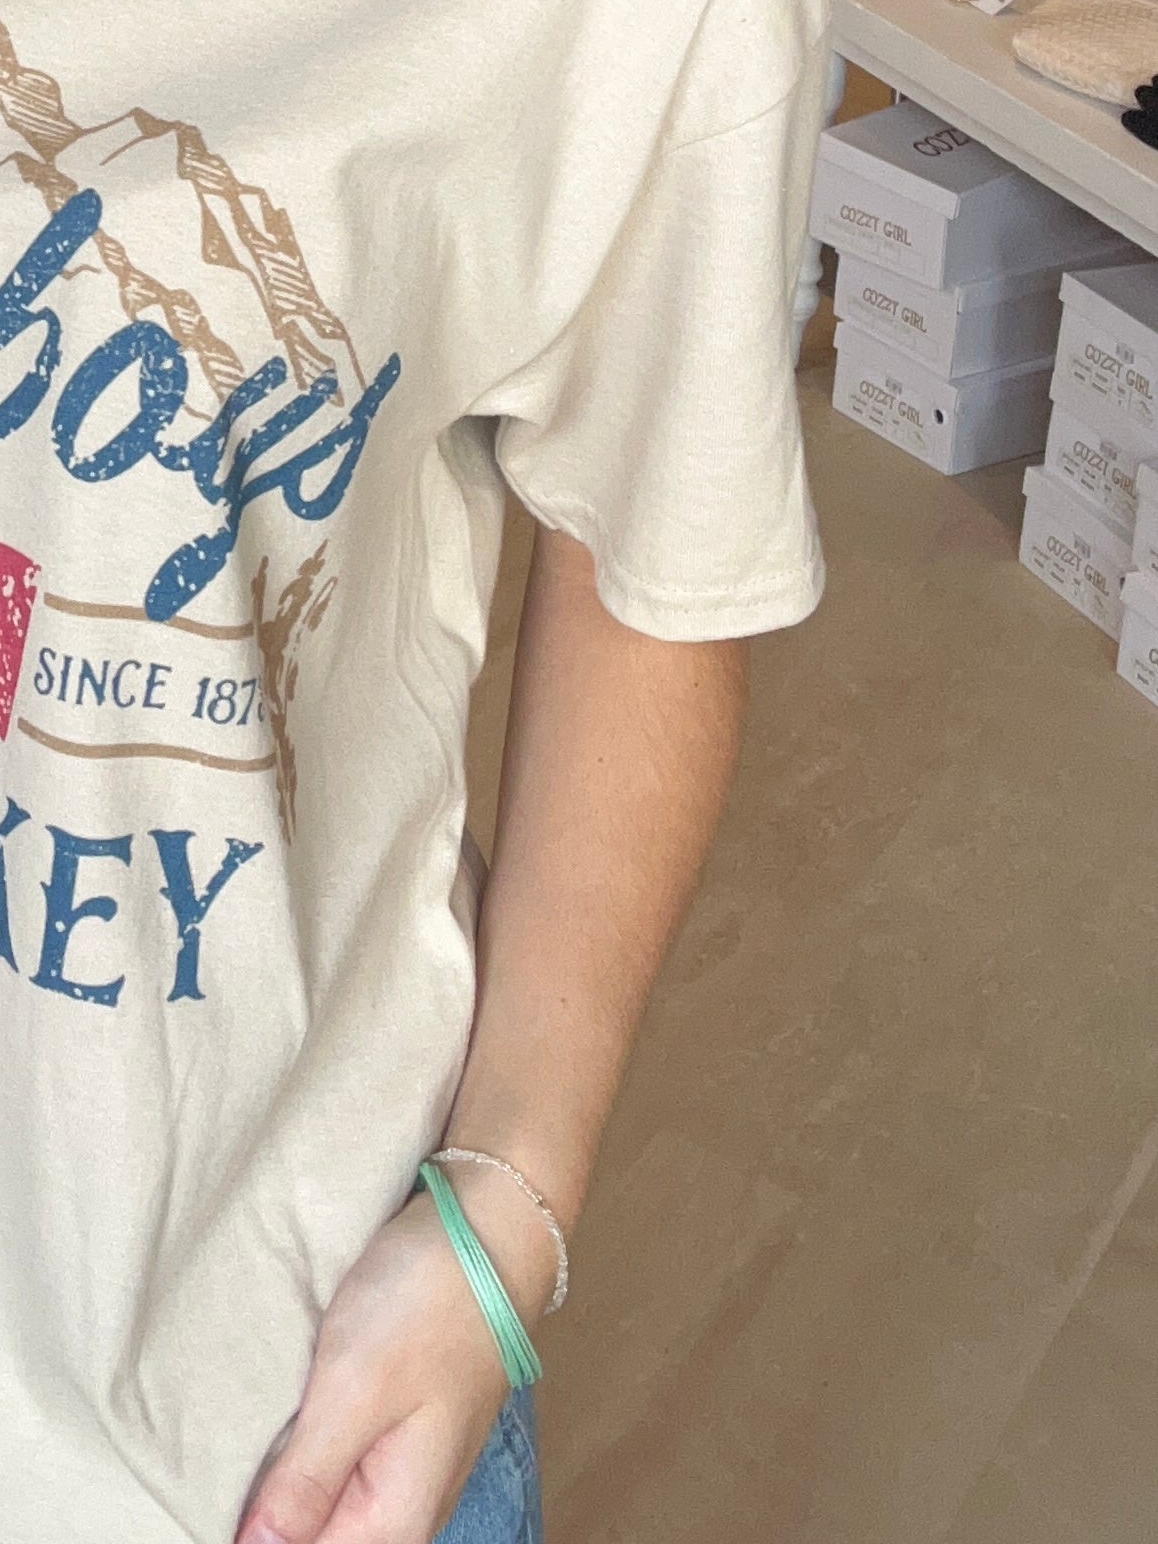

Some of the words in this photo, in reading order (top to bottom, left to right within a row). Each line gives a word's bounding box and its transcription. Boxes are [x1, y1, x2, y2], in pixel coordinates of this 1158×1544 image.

[913, 127, 969, 156] COZ
[840, 205, 880, 232] COZZY
[883, 221, 912, 246] GIRL
[862, 287, 900, 316] COZZY
[901, 307, 928, 333] GIRL
[1084, 343, 1124, 378] COZZY
[1125, 368, 1154, 400] GIRL
[859, 380, 897, 409] COZZY
[897, 401, 924, 428] GIRL
[1073, 440, 1109, 476] COZZY
[1111, 467, 1137, 500] GIRL
[1046, 535, 1083, 572] COZZY
[1083, 564, 1110, 597] GIRL
[33, 647, 172, 709] SINCE
[191, 675, 264, 727] 187
